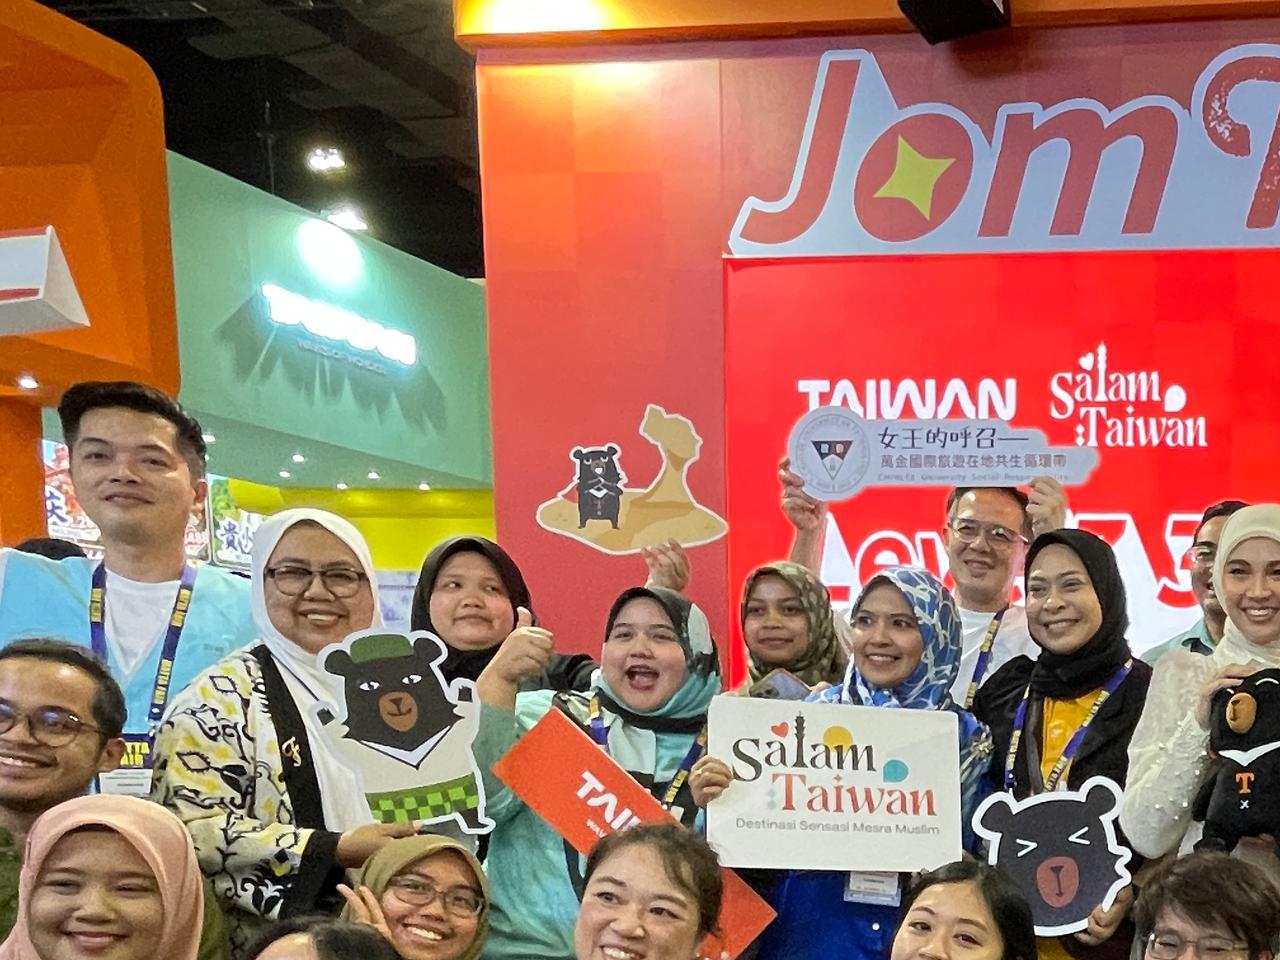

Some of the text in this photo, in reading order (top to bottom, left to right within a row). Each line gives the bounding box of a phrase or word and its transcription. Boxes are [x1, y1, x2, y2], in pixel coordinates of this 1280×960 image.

[738, 58, 1180, 243] Jom
[798, 378, 1017, 420] TAIWAN
[1050, 342, 1160, 421] Salam
[1079, 403, 1208, 448] Taiwan
[732, 711, 877, 782] Salam
[576, 770, 641, 832] TAI
[772, 773, 938, 816] Taiwan
[1236, 772, 1254, 794] T
[735, 817, 940, 836] Destinasi Sensasi Mesra Muslim
